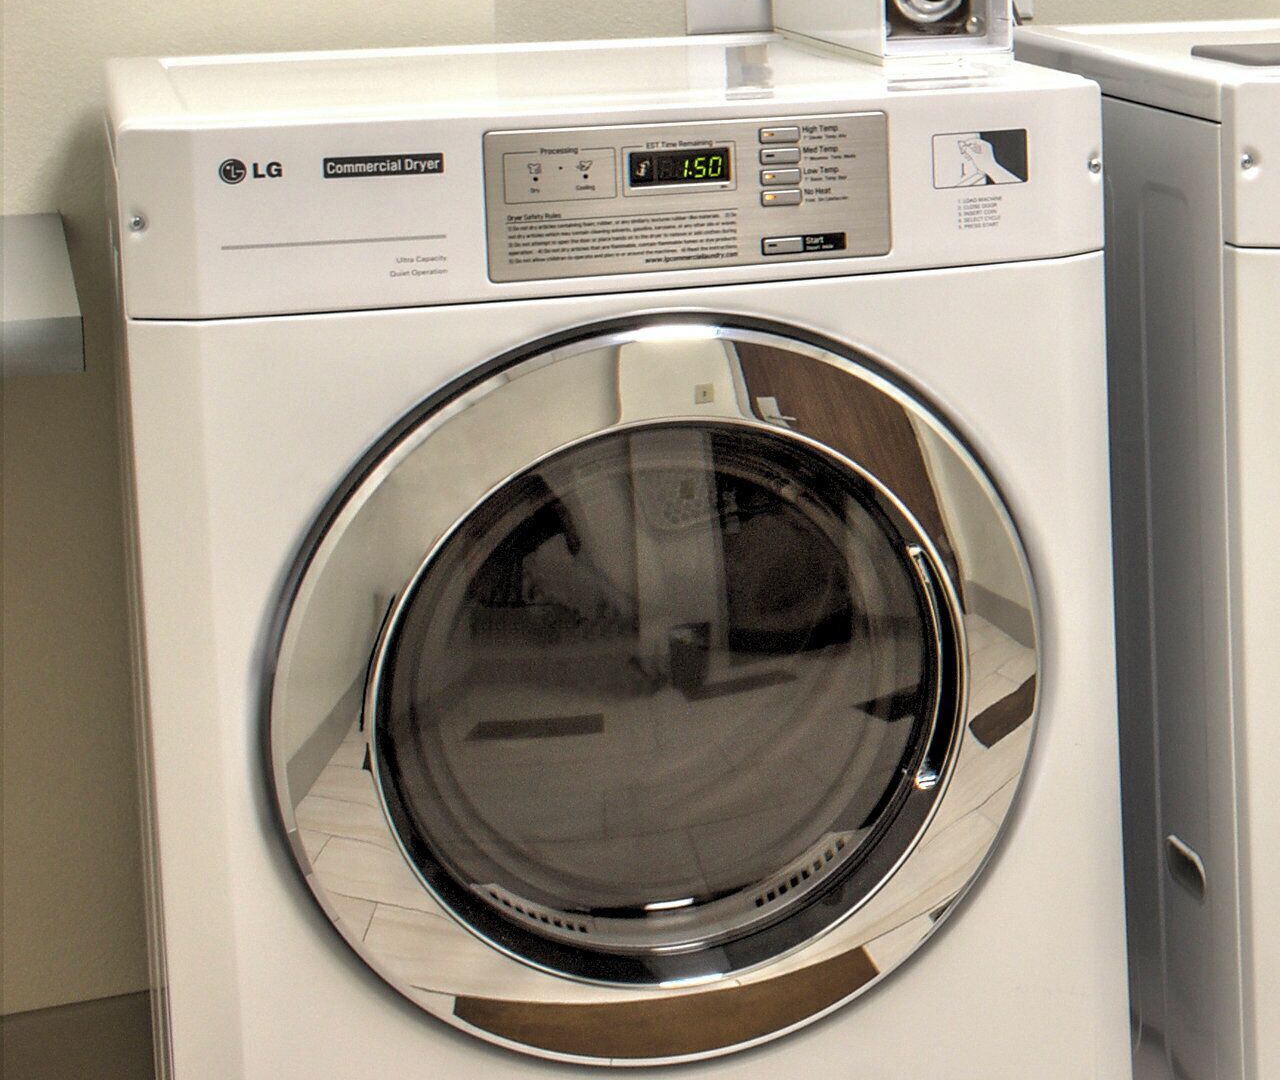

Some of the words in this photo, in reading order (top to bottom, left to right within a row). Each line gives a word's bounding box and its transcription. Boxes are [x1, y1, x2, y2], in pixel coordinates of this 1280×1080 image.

[679, 139, 713, 147] Remaining
[540, 147, 578, 156] Processing
[820, 145, 838, 153] Temp
[253, 161, 283, 179] LG
[326, 159, 402, 175] Commercial
[404, 158, 441, 173] Dryer
[806, 236, 824, 244] Start
